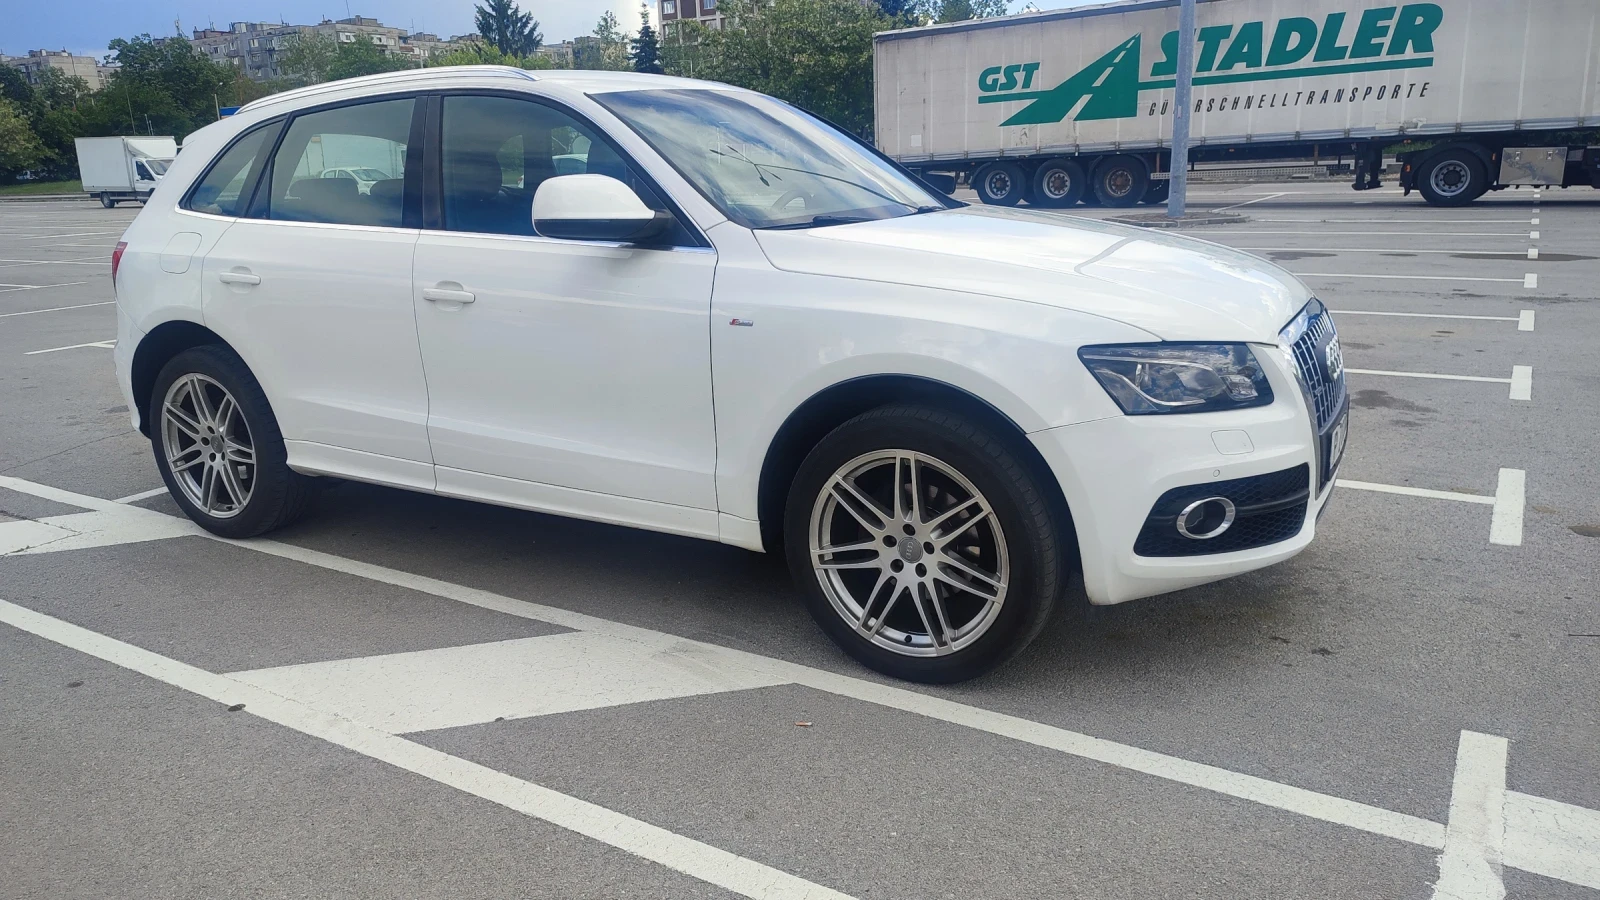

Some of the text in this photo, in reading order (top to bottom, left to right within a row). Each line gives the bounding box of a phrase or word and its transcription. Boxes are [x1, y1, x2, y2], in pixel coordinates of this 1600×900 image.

[1150, 3, 1444, 77] STADLER
[978, 62, 1041, 93] GST
[1148, 82, 1430, 117] GÜRSCHNELLTRANSPORTE
